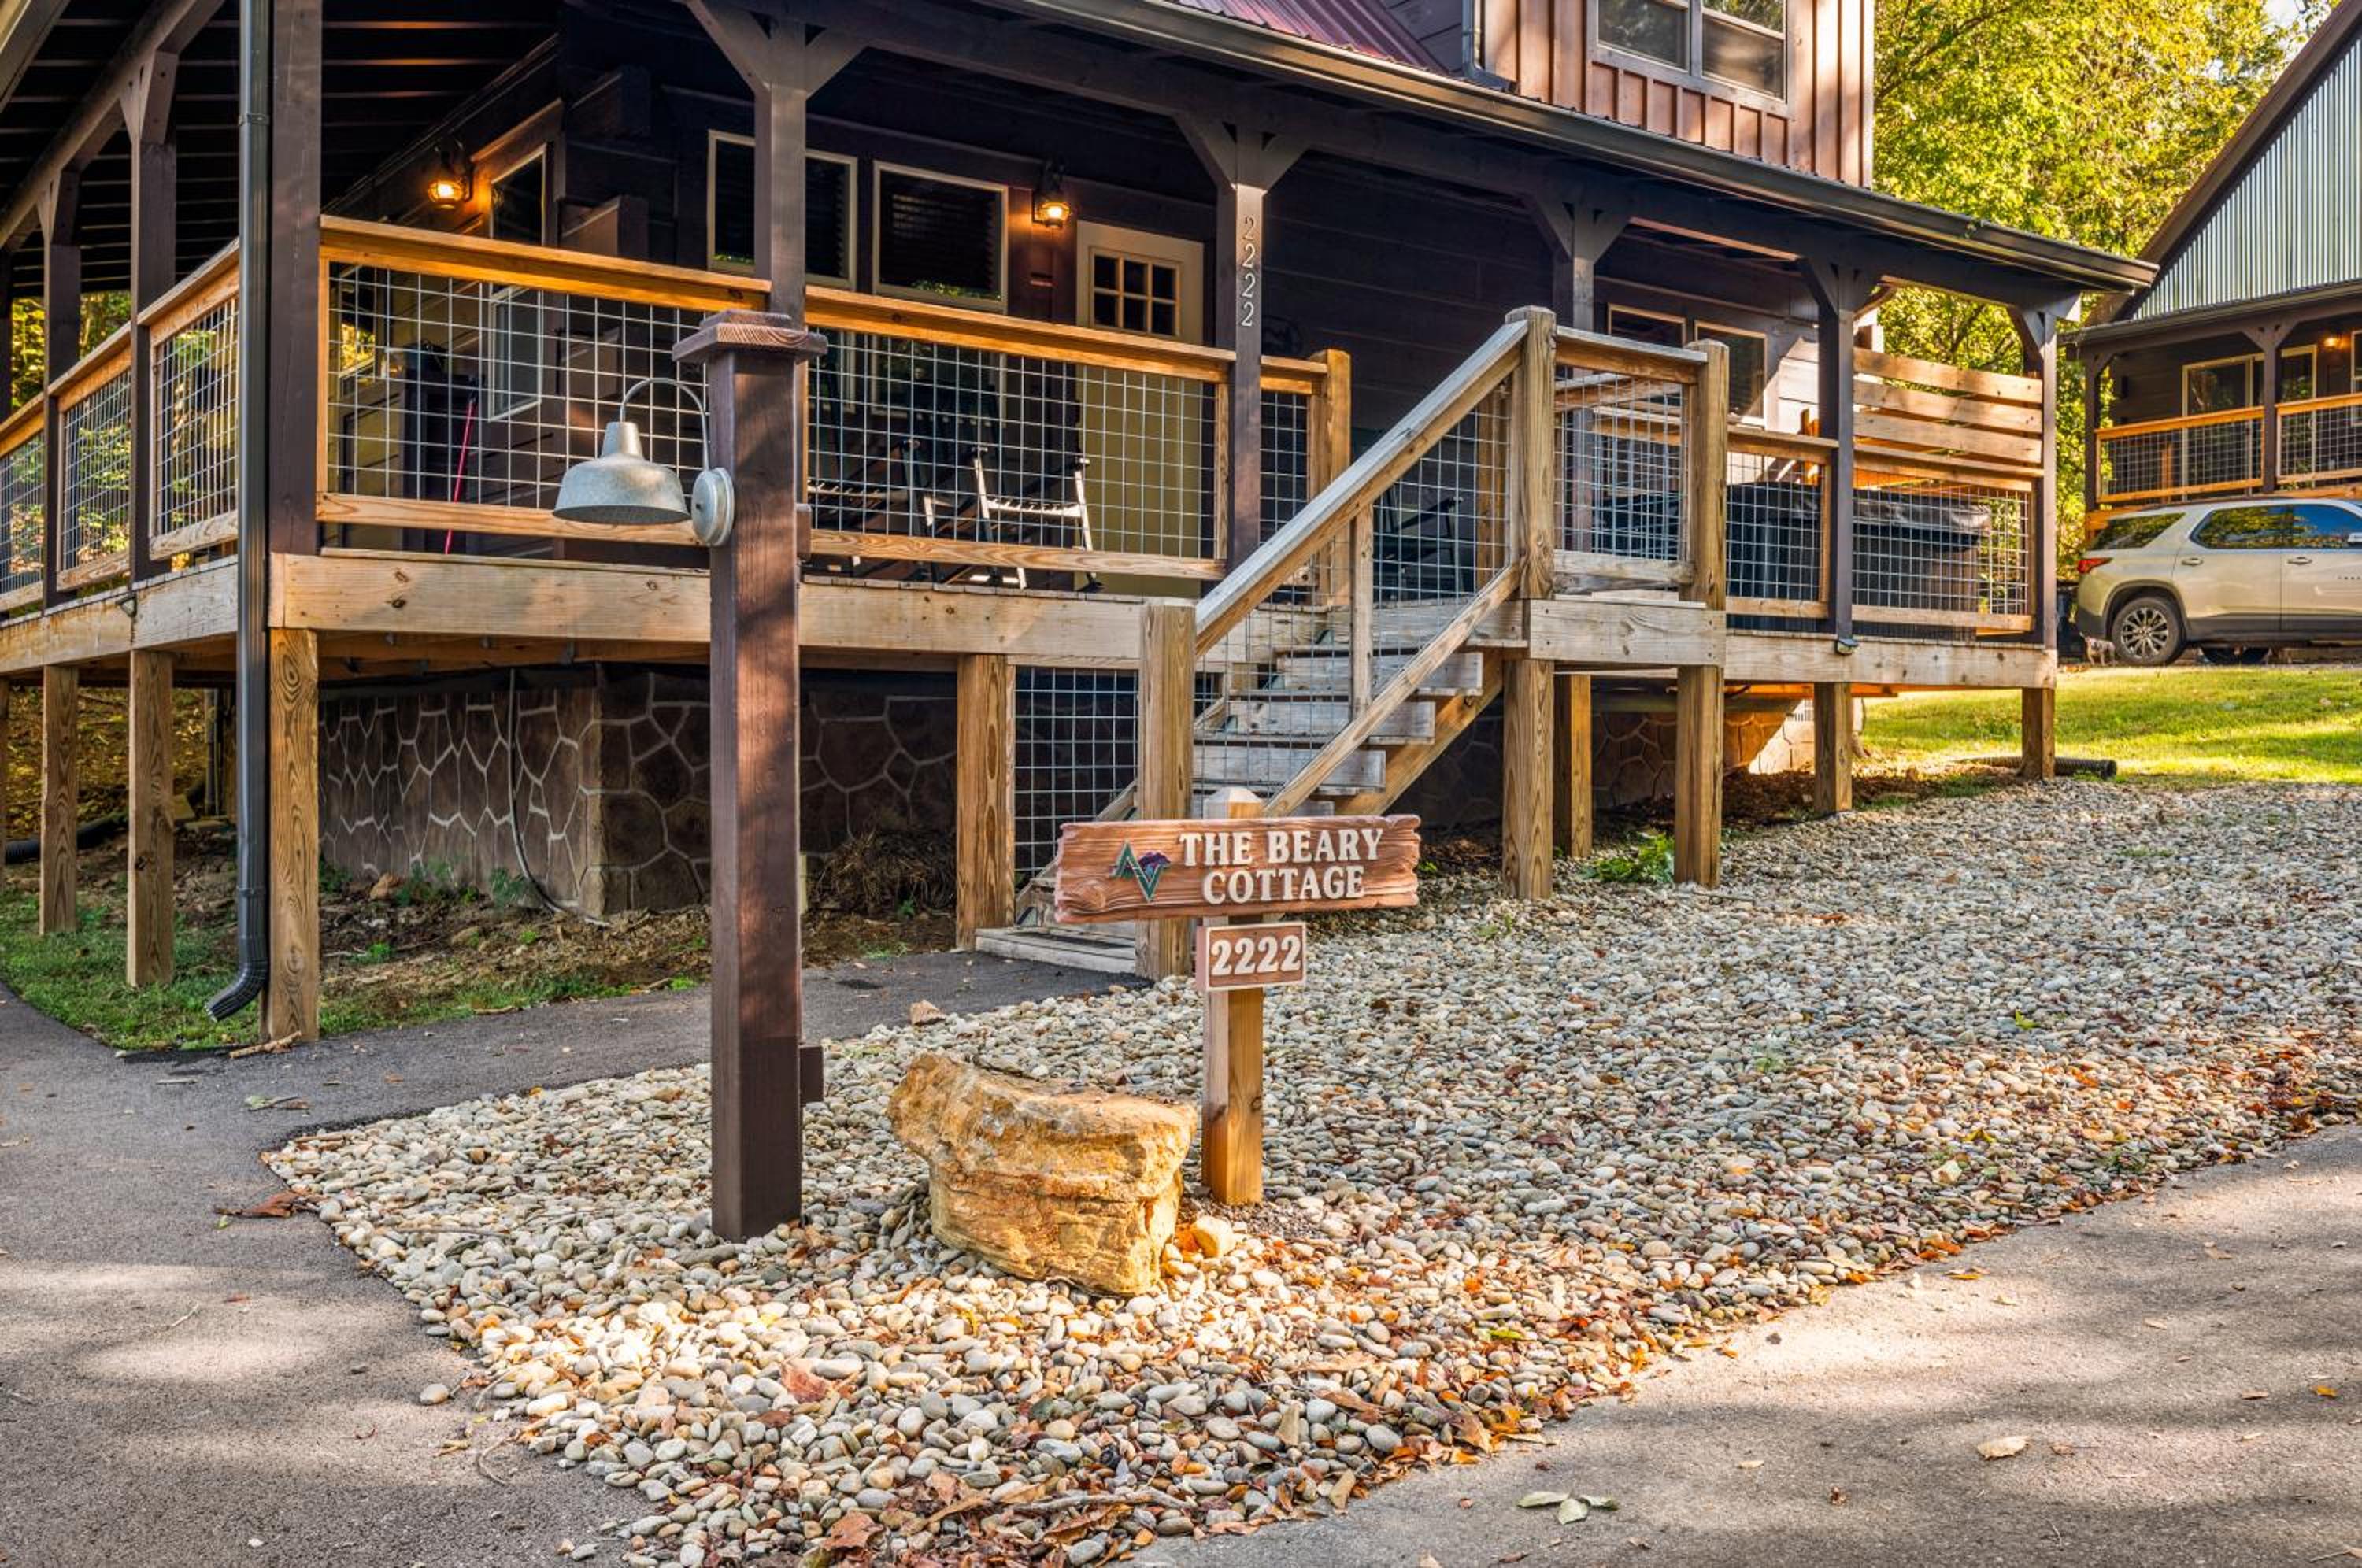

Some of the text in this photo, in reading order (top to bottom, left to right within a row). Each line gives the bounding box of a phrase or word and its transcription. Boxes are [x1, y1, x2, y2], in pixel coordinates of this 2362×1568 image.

[1241, 216, 1256, 327] 2222
[1179, 828, 1383, 866] THE BEARY
[1202, 865, 1365, 904] COTTAGE
[1210, 934, 1301, 976] 2222
